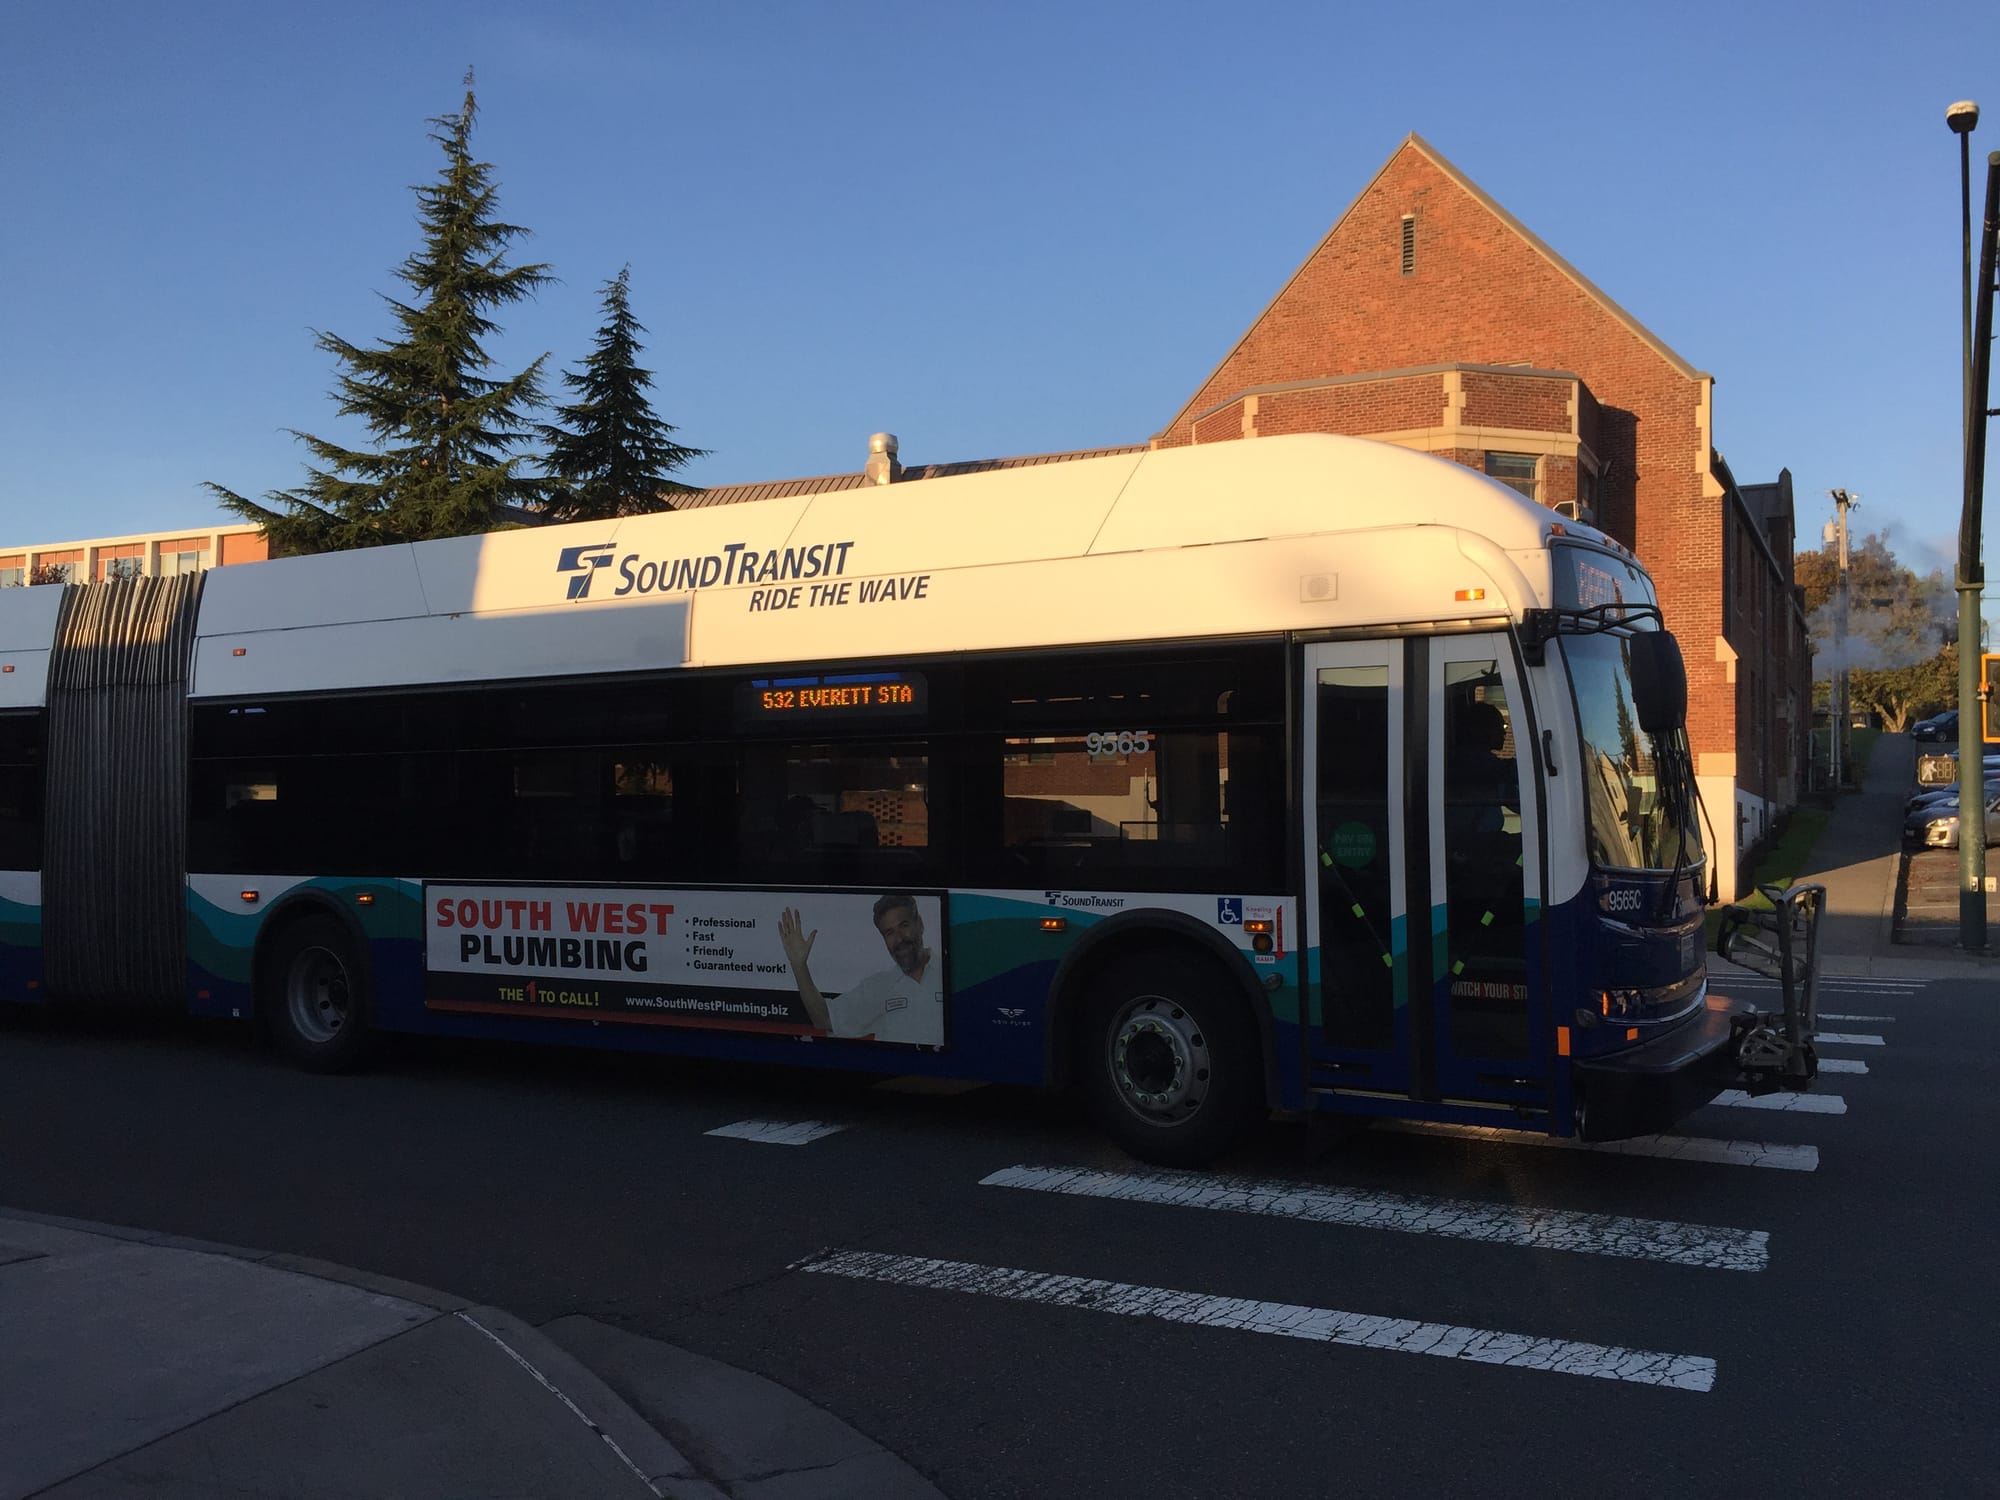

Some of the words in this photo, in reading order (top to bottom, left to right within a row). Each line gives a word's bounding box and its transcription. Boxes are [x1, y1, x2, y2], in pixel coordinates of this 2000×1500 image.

[749, 587, 801, 612] RIDE
[809, 580, 850, 607] THE
[858, 576, 930, 604] WAVE
[763, 690, 795, 710] 532
[800, 686, 872, 708] EVERETT
[878, 684, 913, 704] STA
[1086, 730, 1150, 756] 9565
[1608, 889, 1641, 911] 9565C
[436, 898, 551, 931] SOUTH
[566, 902, 674, 936] WEST
[692, 917, 756, 929] Professional
[692, 931, 715, 942] Fast
[460, 934, 648, 972] PLUMBING
[693, 945, 734, 959] Friendly
[693, 960, 753, 972] Guaranteed
[756, 963, 787, 974] work!
[498, 987, 524, 1002] THE
[526, 981, 538, 1004] 1
[538, 990, 556, 1004] TO
[559, 990, 600, 1007] CALL!
[1483, 982, 1510, 998] YOUR
[625, 996, 789, 1017] www.SouthWestPlumbing.biz
